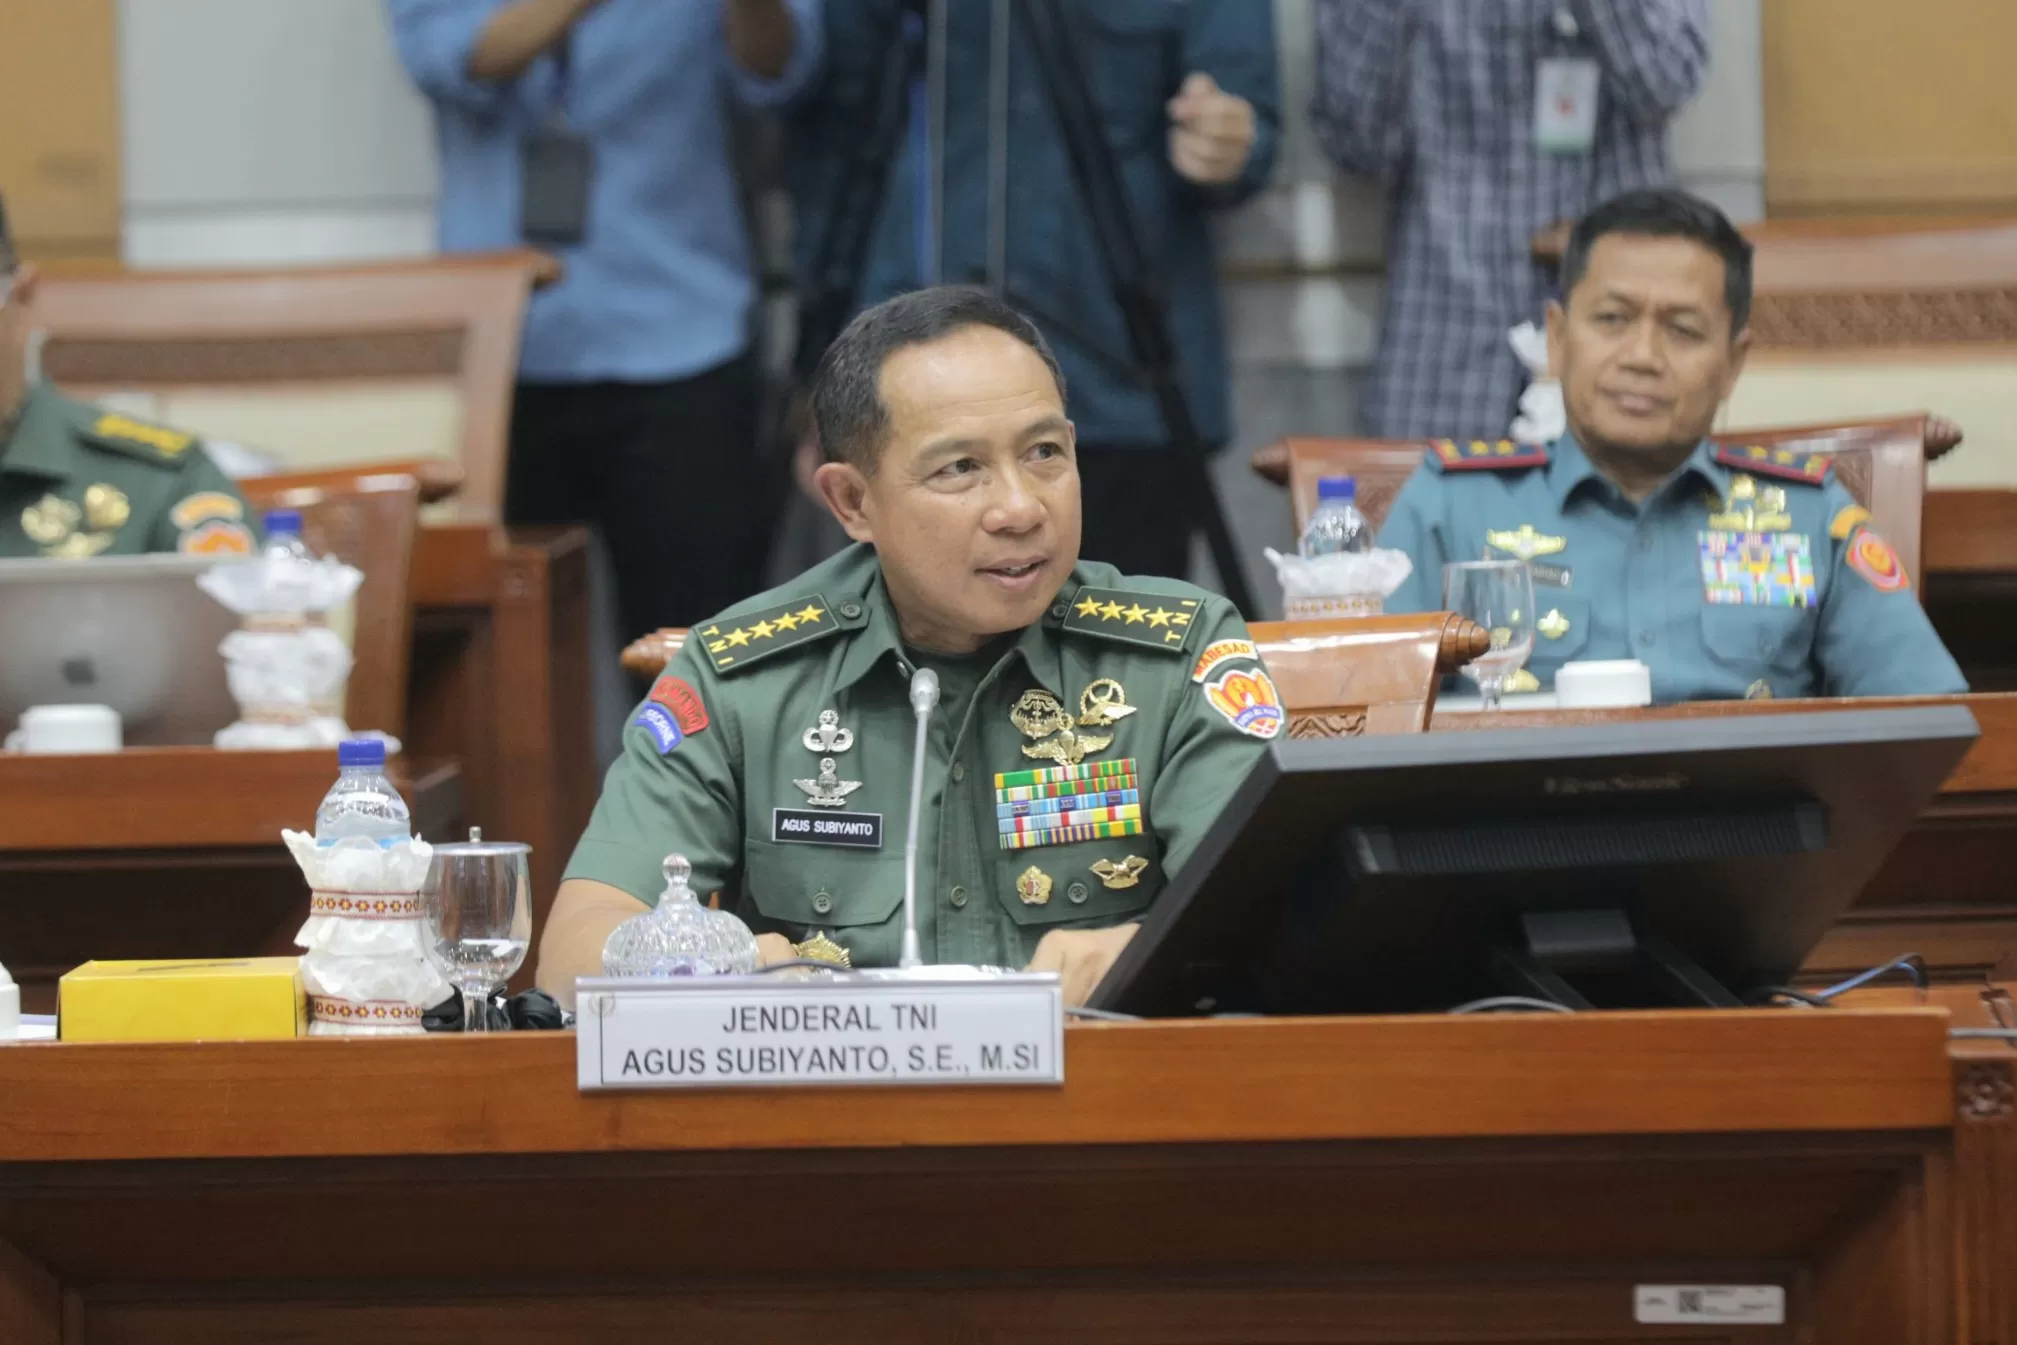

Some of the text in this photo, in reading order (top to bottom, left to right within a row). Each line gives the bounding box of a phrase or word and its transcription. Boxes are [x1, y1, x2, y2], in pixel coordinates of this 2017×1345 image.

[1164, 600, 1197, 643] TNI
[702, 625, 735, 665] TNI
[781, 818, 873, 836] AGUS SUBIYANTO
[722, 1003, 937, 1034] JENDERAL TNI
[622, 1044, 1040, 1078] AGUS SUBIYANTO, S.E., M.SI
